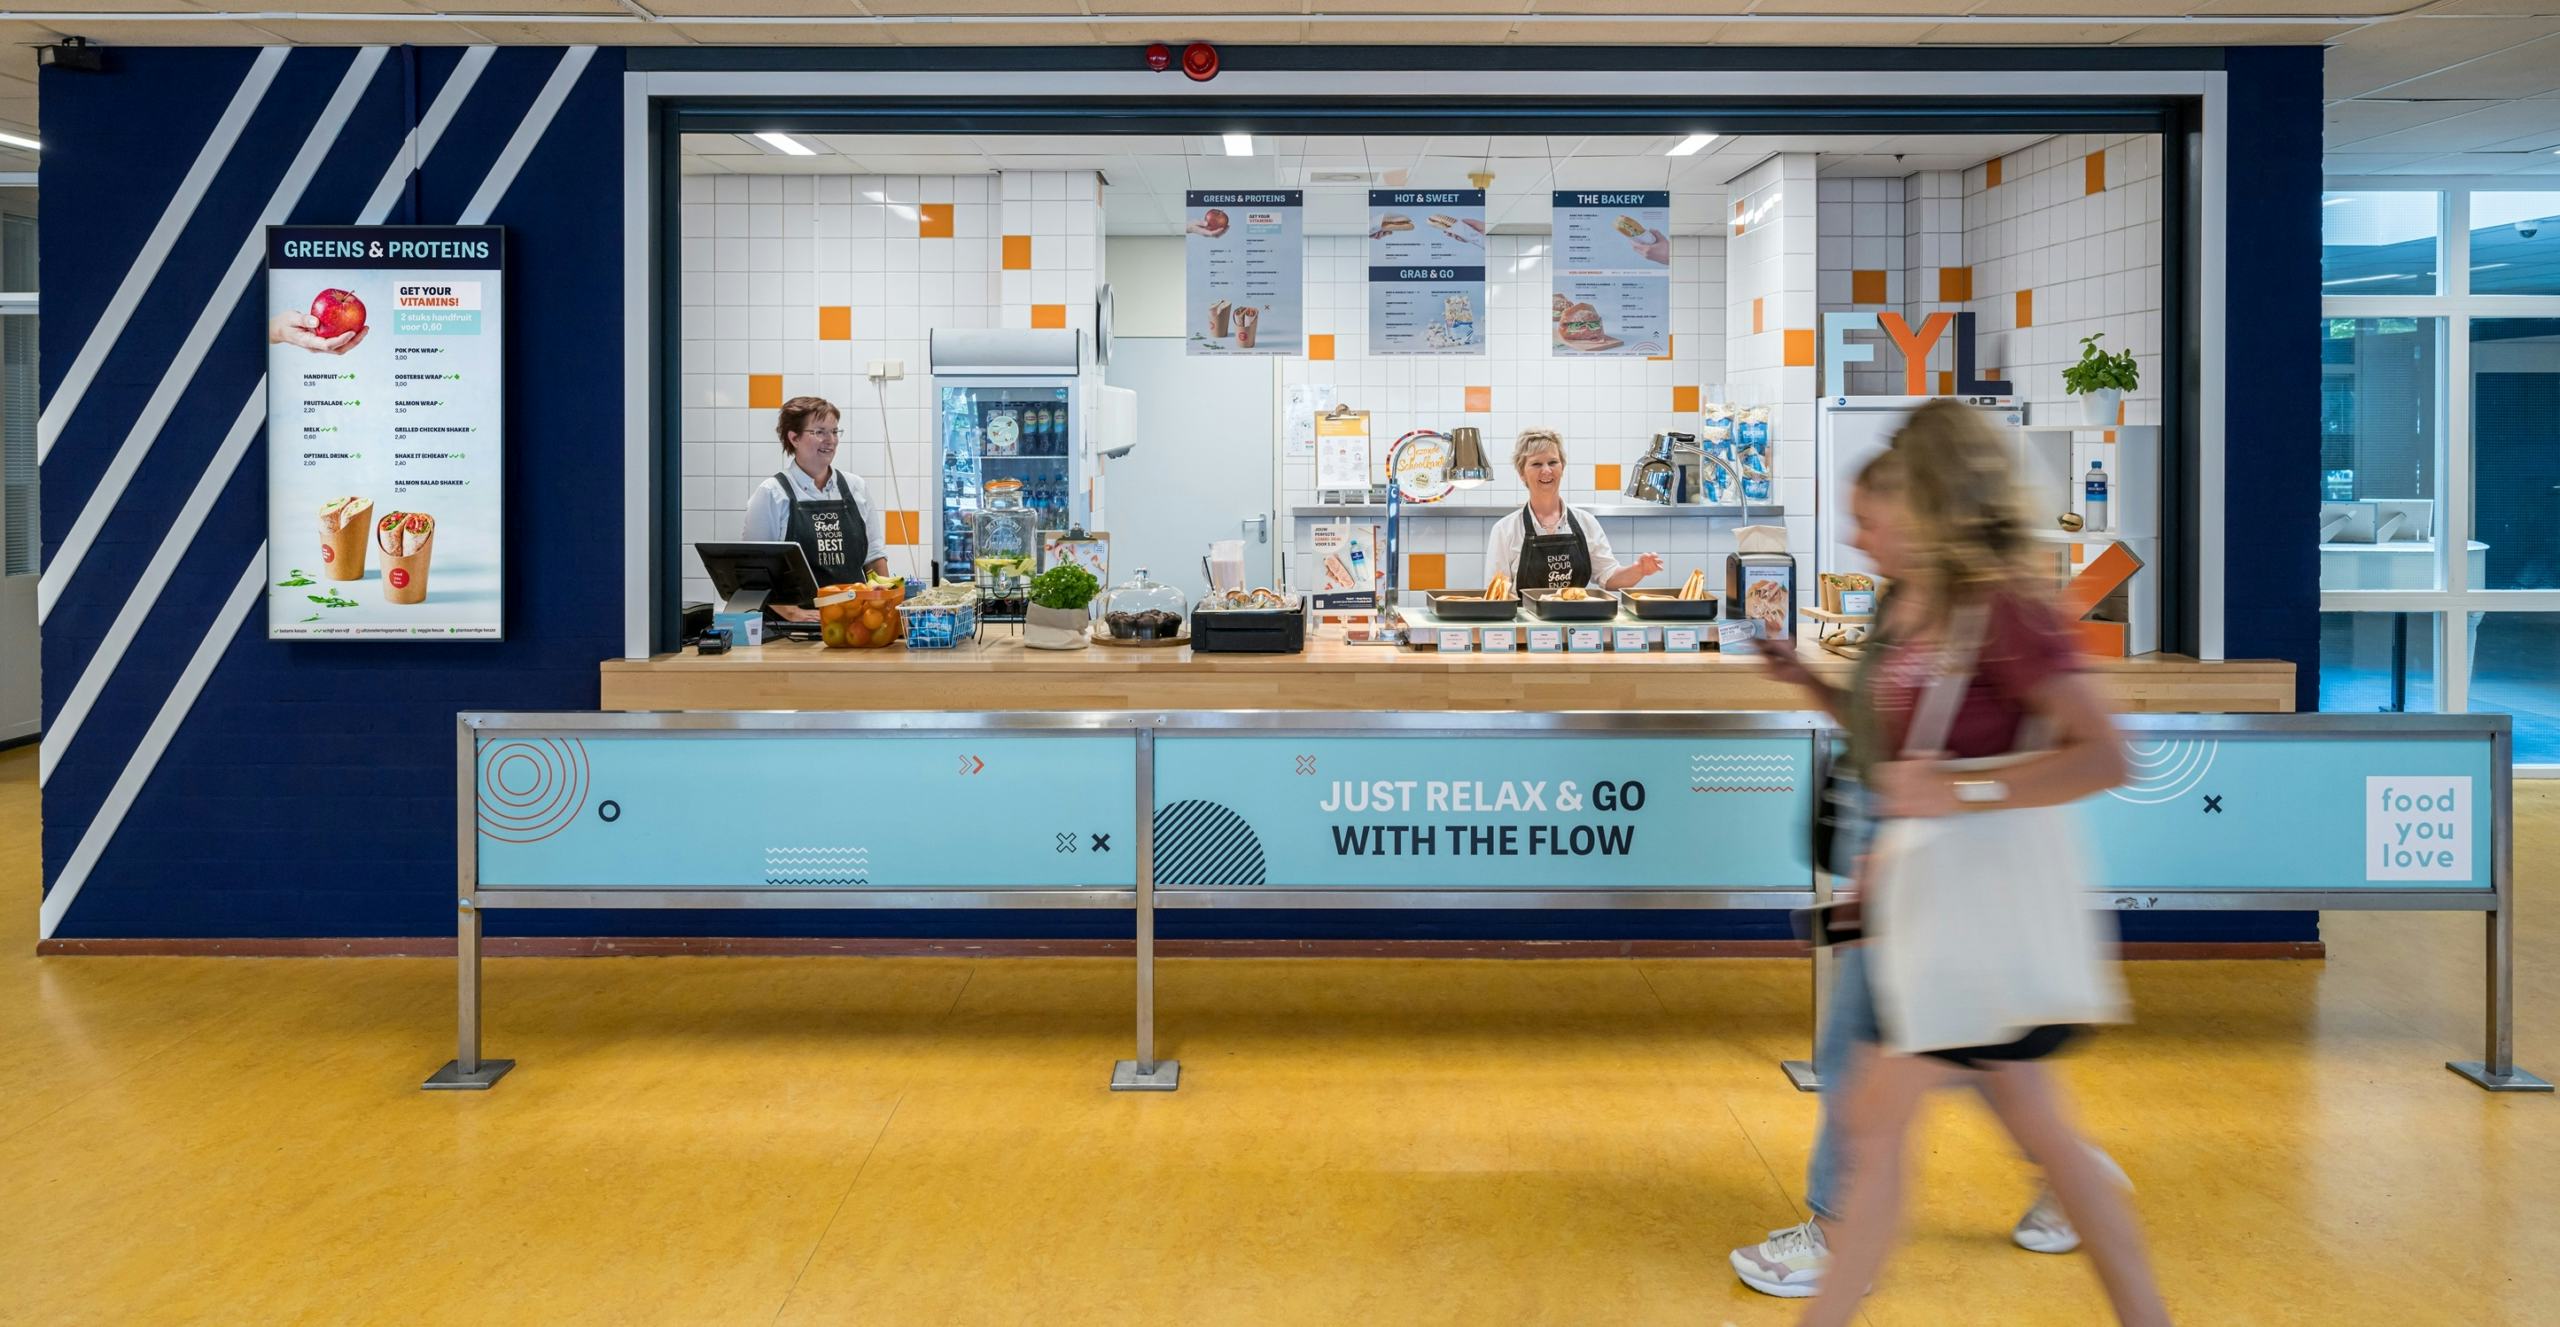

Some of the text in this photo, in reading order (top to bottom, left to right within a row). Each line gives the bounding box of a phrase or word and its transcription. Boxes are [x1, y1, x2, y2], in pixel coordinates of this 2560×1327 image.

[1203, 194, 1286, 202] GREENS & PROTEINS
[1395, 194, 1459, 202] HOT & SWEET
[1577, 195, 1645, 204] THE BAKERY
[284, 240, 490, 259] GREENS & PROTEINS
[1400, 269, 1455, 278] GRAB & GO
[400, 287, 451, 295] GET YOUR
[400, 298, 459, 306] VITAMINS!
[401, 313, 472, 321] 2 stuks handfruit
[1823, 311, 2013, 396] FYL
[815, 520, 840, 531] Food
[818, 539, 843, 551] BEST
[818, 552, 845, 565] FRIEND
[1548, 554, 1570, 562] ENJOY
[1548, 561, 1571, 570] YOUR
[1548, 569, 1573, 581] Food
[1320, 780, 1646, 812] JUST RELAX & GO
[2381, 787, 2455, 813] food
[2395, 822, 2454, 846] you
[1332, 825, 1635, 857] WITH THE FLOW
[2382, 843, 2455, 868] love
